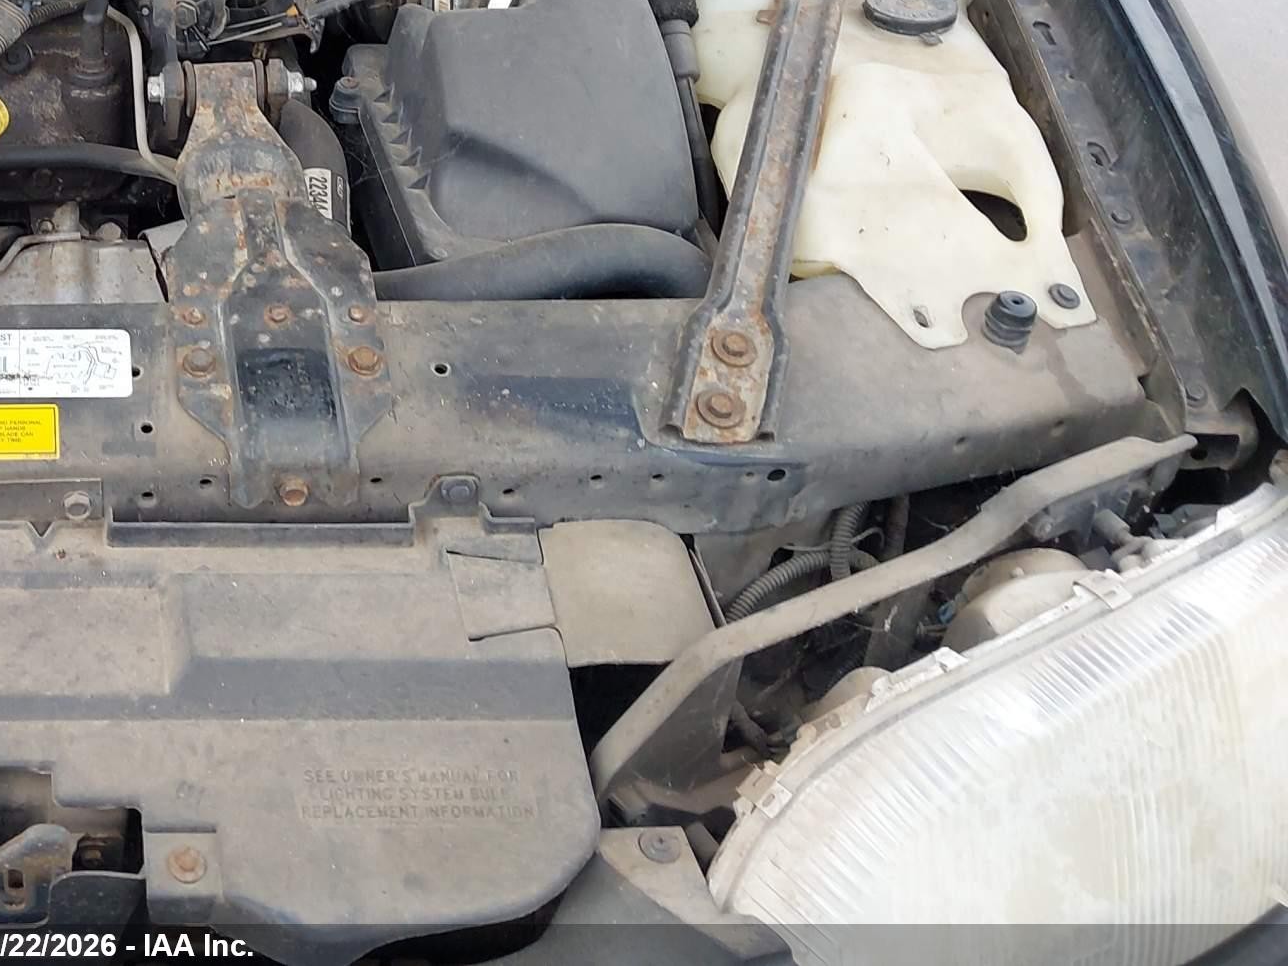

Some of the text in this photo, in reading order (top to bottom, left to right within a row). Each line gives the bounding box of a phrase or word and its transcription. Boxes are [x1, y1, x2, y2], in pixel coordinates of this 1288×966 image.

[304, 769, 519, 783] SEE OWNER'S MANUAL FOR
[320, 786, 393, 801] LIGHTING
[399, 787, 464, 801] SYSTEM
[302, 805, 537, 819] REPLACEMENT INFORMATION
